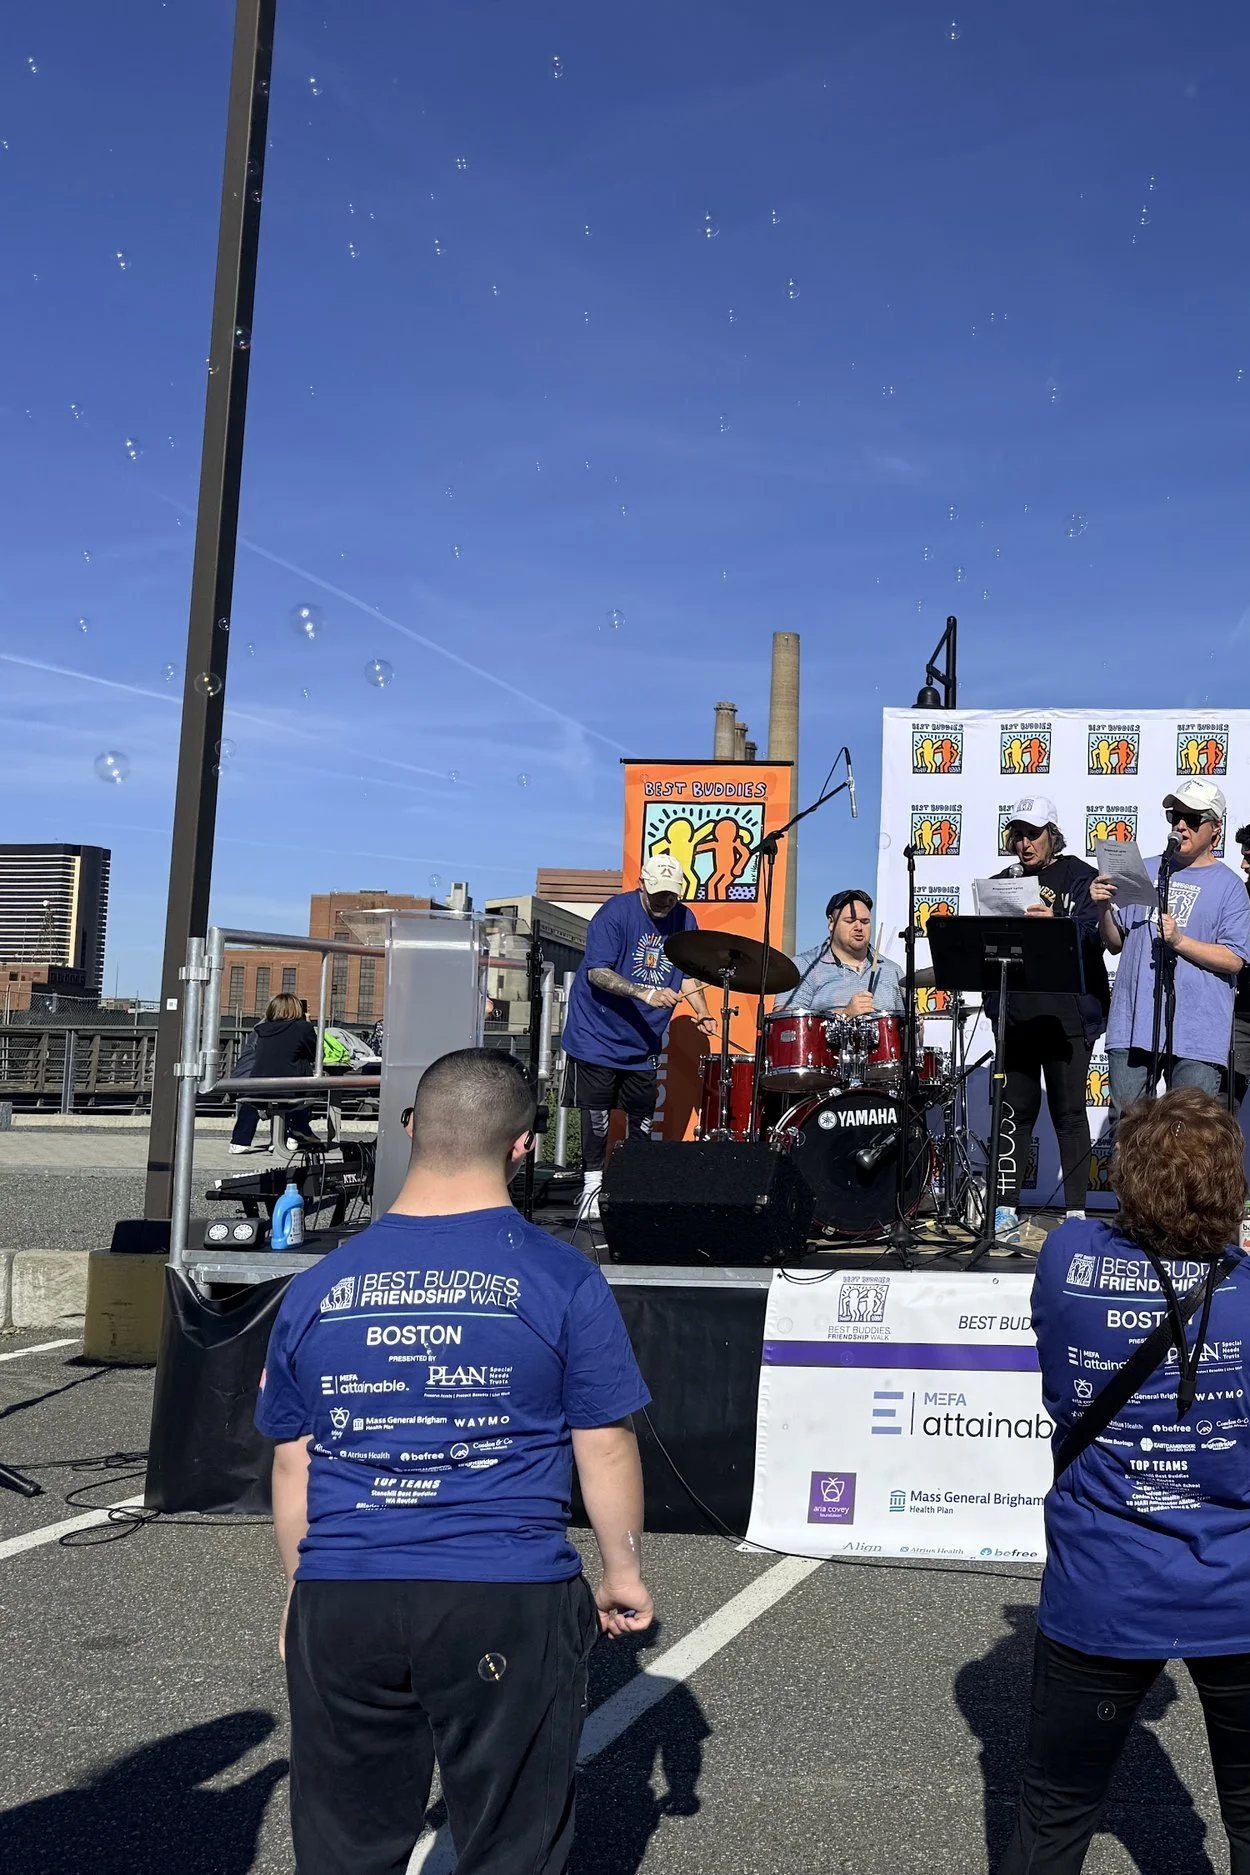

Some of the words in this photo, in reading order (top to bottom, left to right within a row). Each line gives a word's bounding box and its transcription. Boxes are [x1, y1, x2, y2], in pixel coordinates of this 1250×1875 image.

[644, 781, 687, 796] BEST
[692, 781, 767, 798] BUDDIES
[837, 1108, 898, 1127] YAMAHA
[1102, 1257, 1151, 1278] BEST
[364, 1271, 420, 1290] BEST
[361, 1290, 466, 1307] FRIENDSHIP
[470, 1291, 519, 1309] WALK
[958, 1315, 998, 1330] BEST
[1107, 1309, 1180, 1329] BOST
[366, 1325, 462, 1346] BOSTON
[828, 1326, 851, 1334] BEST
[853, 1326, 891, 1335] BUDDIES
[339, 1374, 358, 1382] MEFA
[426, 1365, 488, 1386] PLAN
[924, 1391, 967, 1407] MEFA
[1160, 1392, 1178, 1400] Brigh
[1195, 1389, 1244, 1402] WAYMO
[366, 1416, 386, 1425] Mass
[387, 1416, 416, 1425] General
[417, 1415, 447, 1426] Brigham
[454, 1416, 510, 1428] WAYMO
[922, 1412, 1053, 1439] attainab
[1161, 1424, 1191, 1433] befree
[368, 1450, 390, 1459] Health
[411, 1452, 444, 1461] befree
[1130, 1460, 1150, 1471] TOP
[1152, 1460, 1188, 1471] TEAMS
[400, 1479, 441, 1489] TEAMS
[910, 1490, 942, 1503] Mass
[944, 1491, 990, 1505] General
[994, 1493, 1044, 1509] Brigham
[813, 1505, 827, 1513] aria
[827, 1506, 850, 1515] covey
[910, 1505, 934, 1514] Health
[936, 1506, 954, 1515] Plan
[843, 1541, 882, 1553] Align
[937, 1547, 964, 1555] Health
[993, 1548, 1038, 1558] befree
